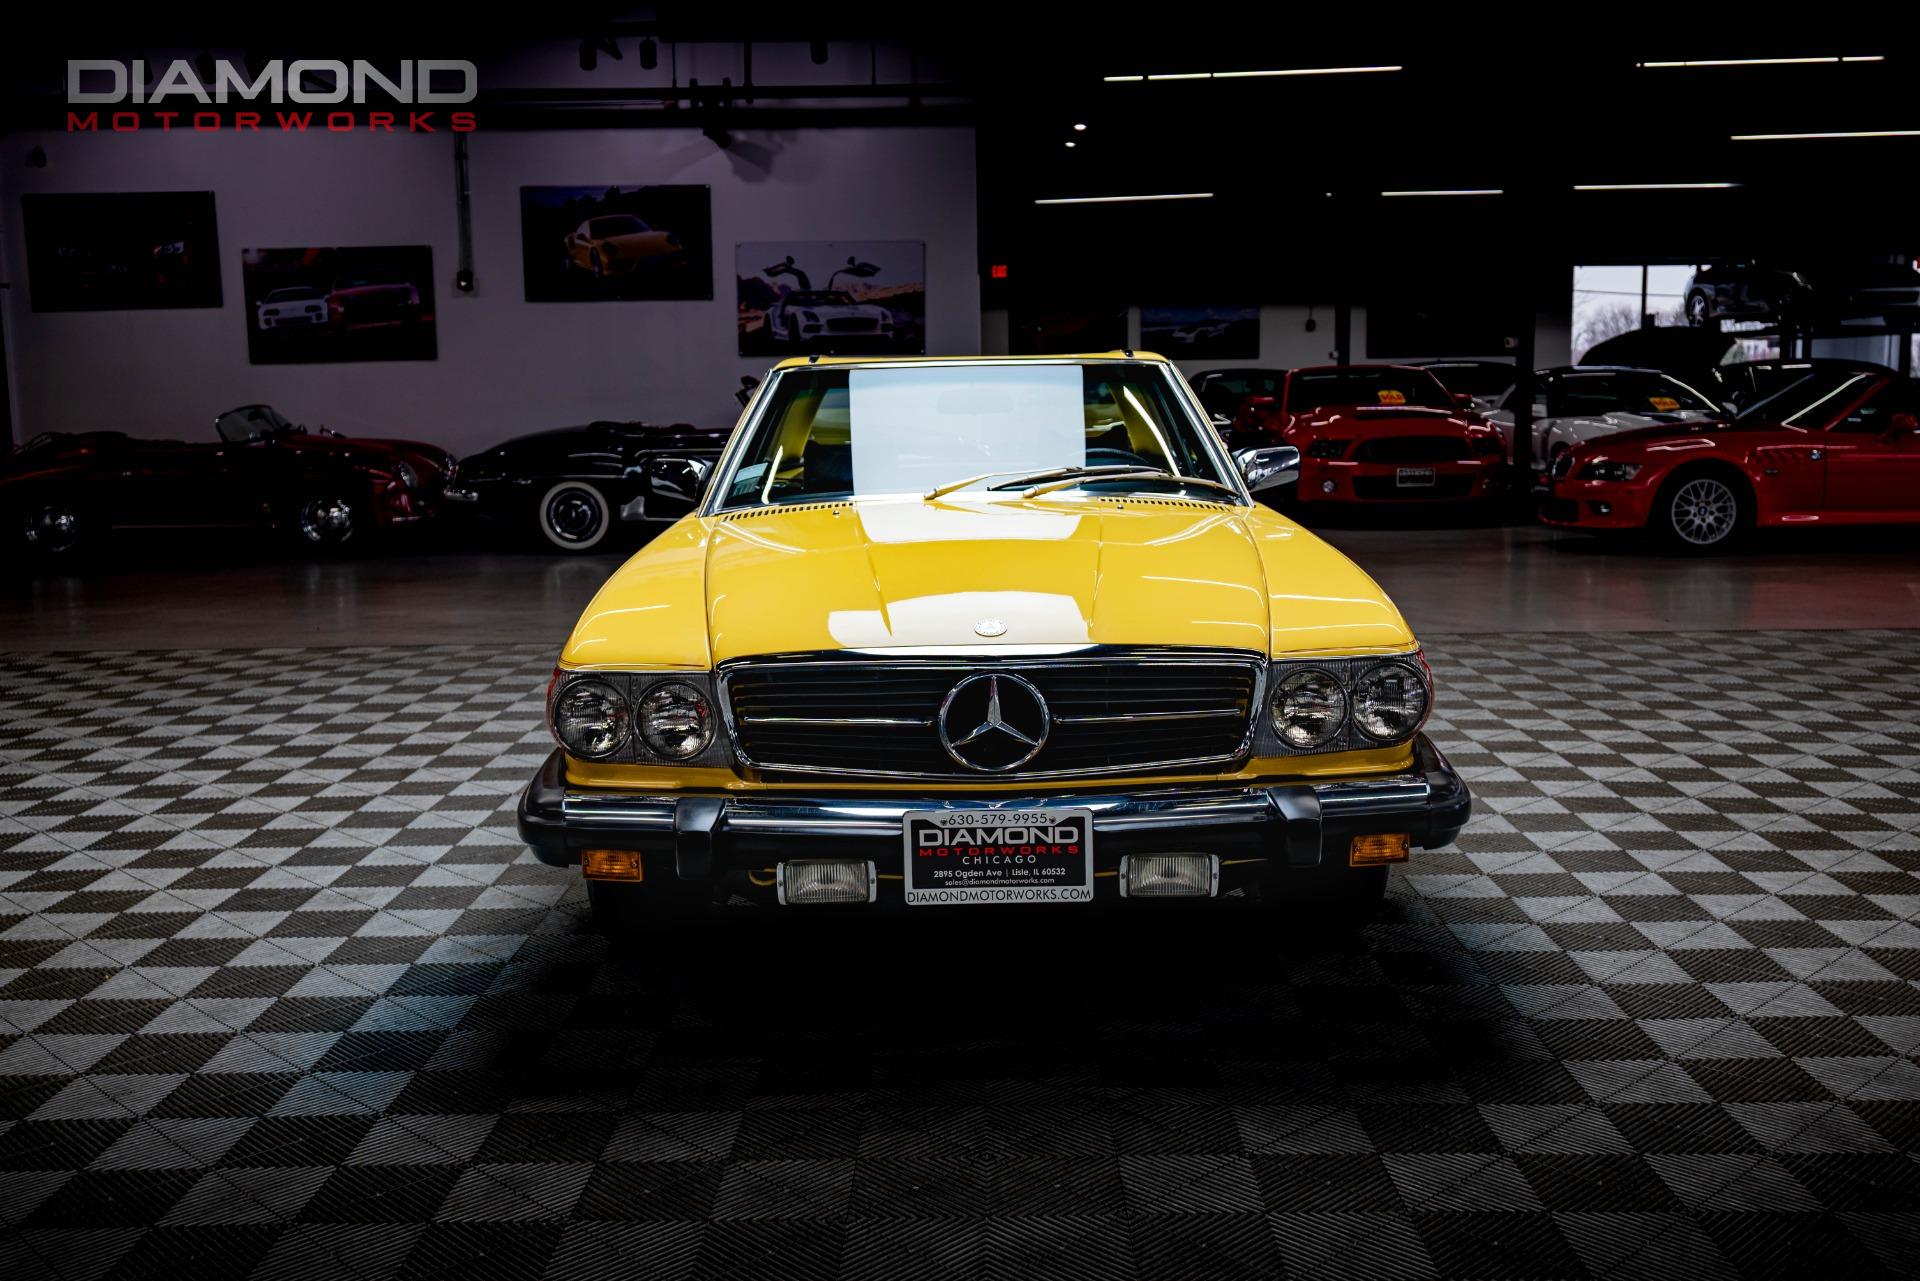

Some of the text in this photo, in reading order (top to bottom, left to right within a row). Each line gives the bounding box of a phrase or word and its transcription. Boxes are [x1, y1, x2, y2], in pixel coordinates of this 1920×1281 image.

[948, 813, 1048, 825] 630-579-9955
[919, 826, 1079, 847] DIAMOND
[919, 845, 1079, 857] MOTORWORKS
[962, 854, 1037, 865] CHICAGO
[933, 870, 953, 878] 2895
[955, 870, 984, 879] Ogden
[985, 869, 1003, 877] Ave
[1033, 868, 1040, 876] IL
[1041, 867, 1066, 876] 60532
[944, 878, 1055, 886] sales@diamondmotorworks.com
[907, 888, 1091, 903] DIAMONDMOTORWORKS.COM
